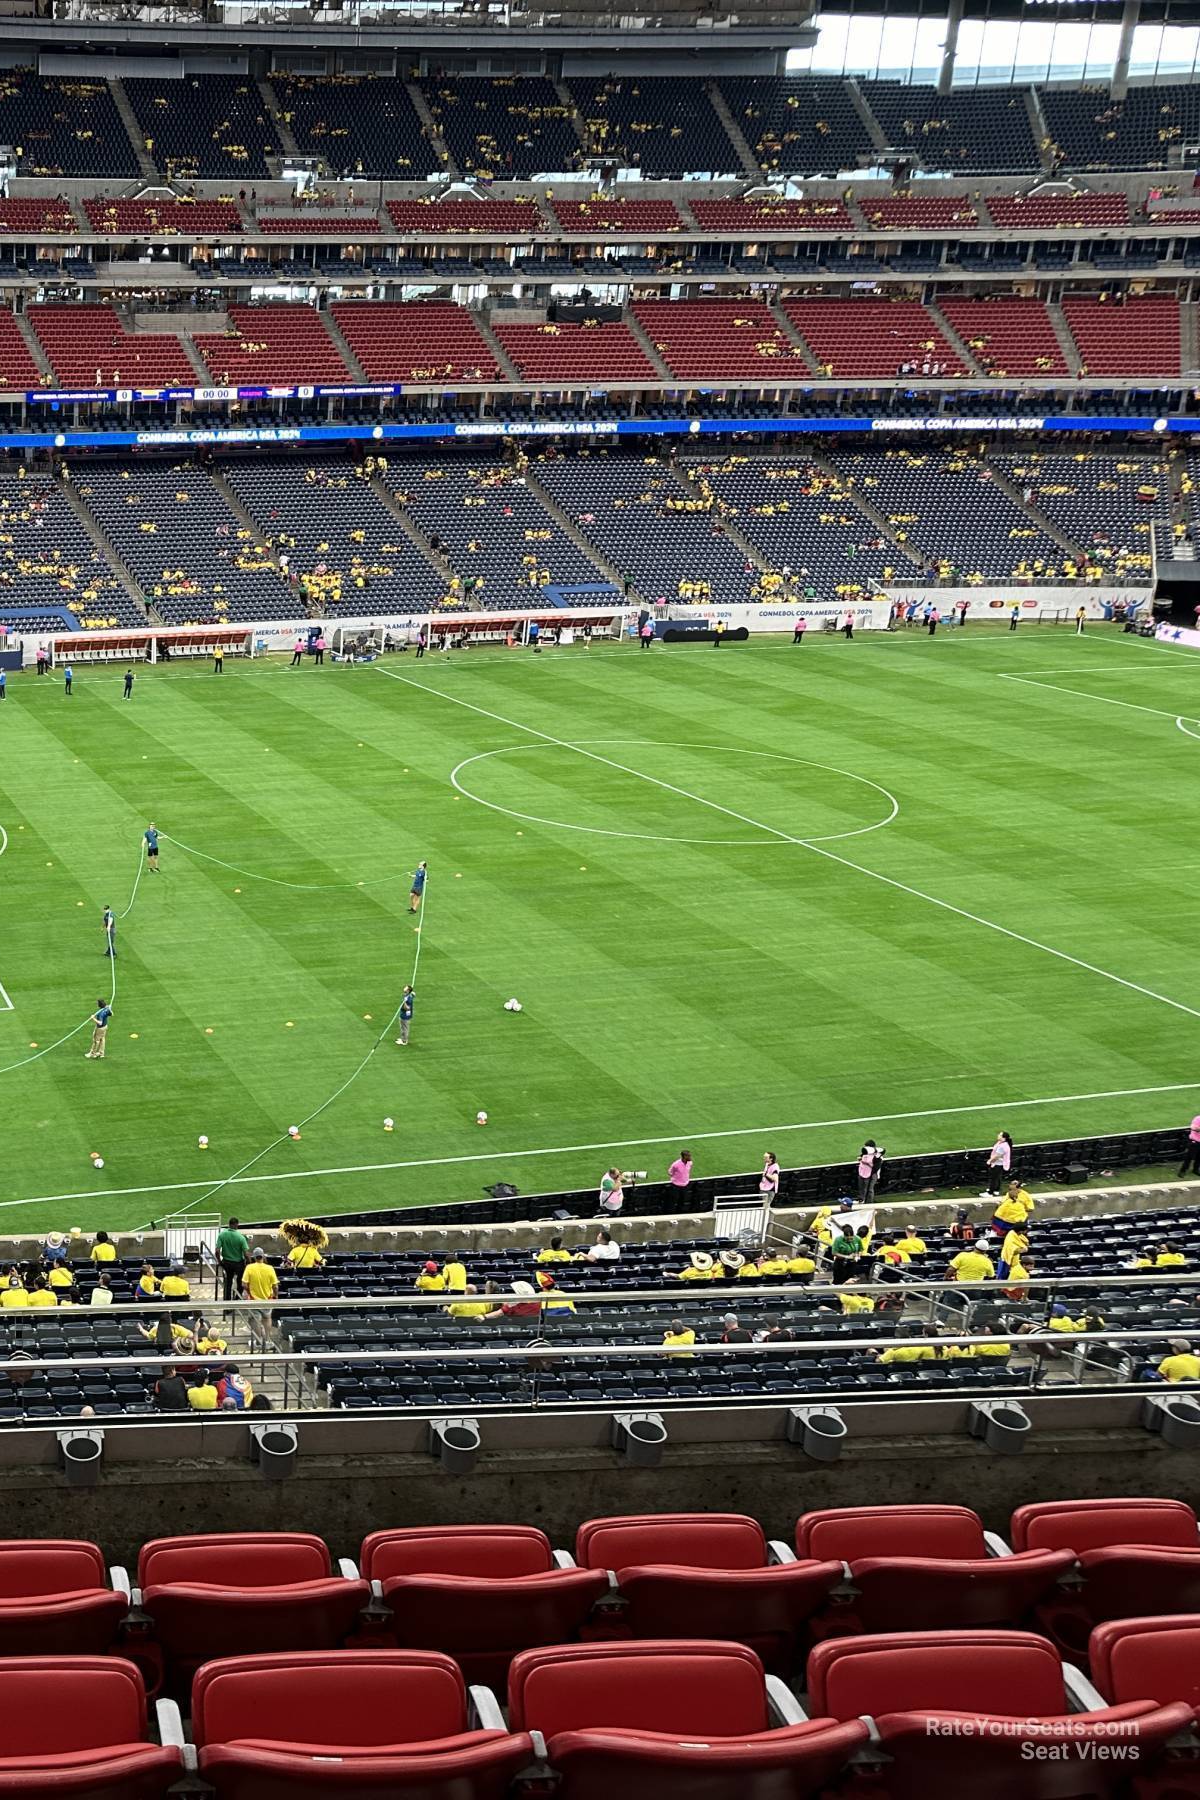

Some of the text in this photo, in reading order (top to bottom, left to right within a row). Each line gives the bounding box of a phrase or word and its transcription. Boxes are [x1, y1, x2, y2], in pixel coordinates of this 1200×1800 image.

[455, 423, 618, 434] CONMEBOL COPA AMERICA USA 2024
[872, 418, 1044, 430] CONMEBOL COPA AMERICA USA 2024
[137, 430, 301, 442] CONMEBOL COPA AMERICA USA 2024
